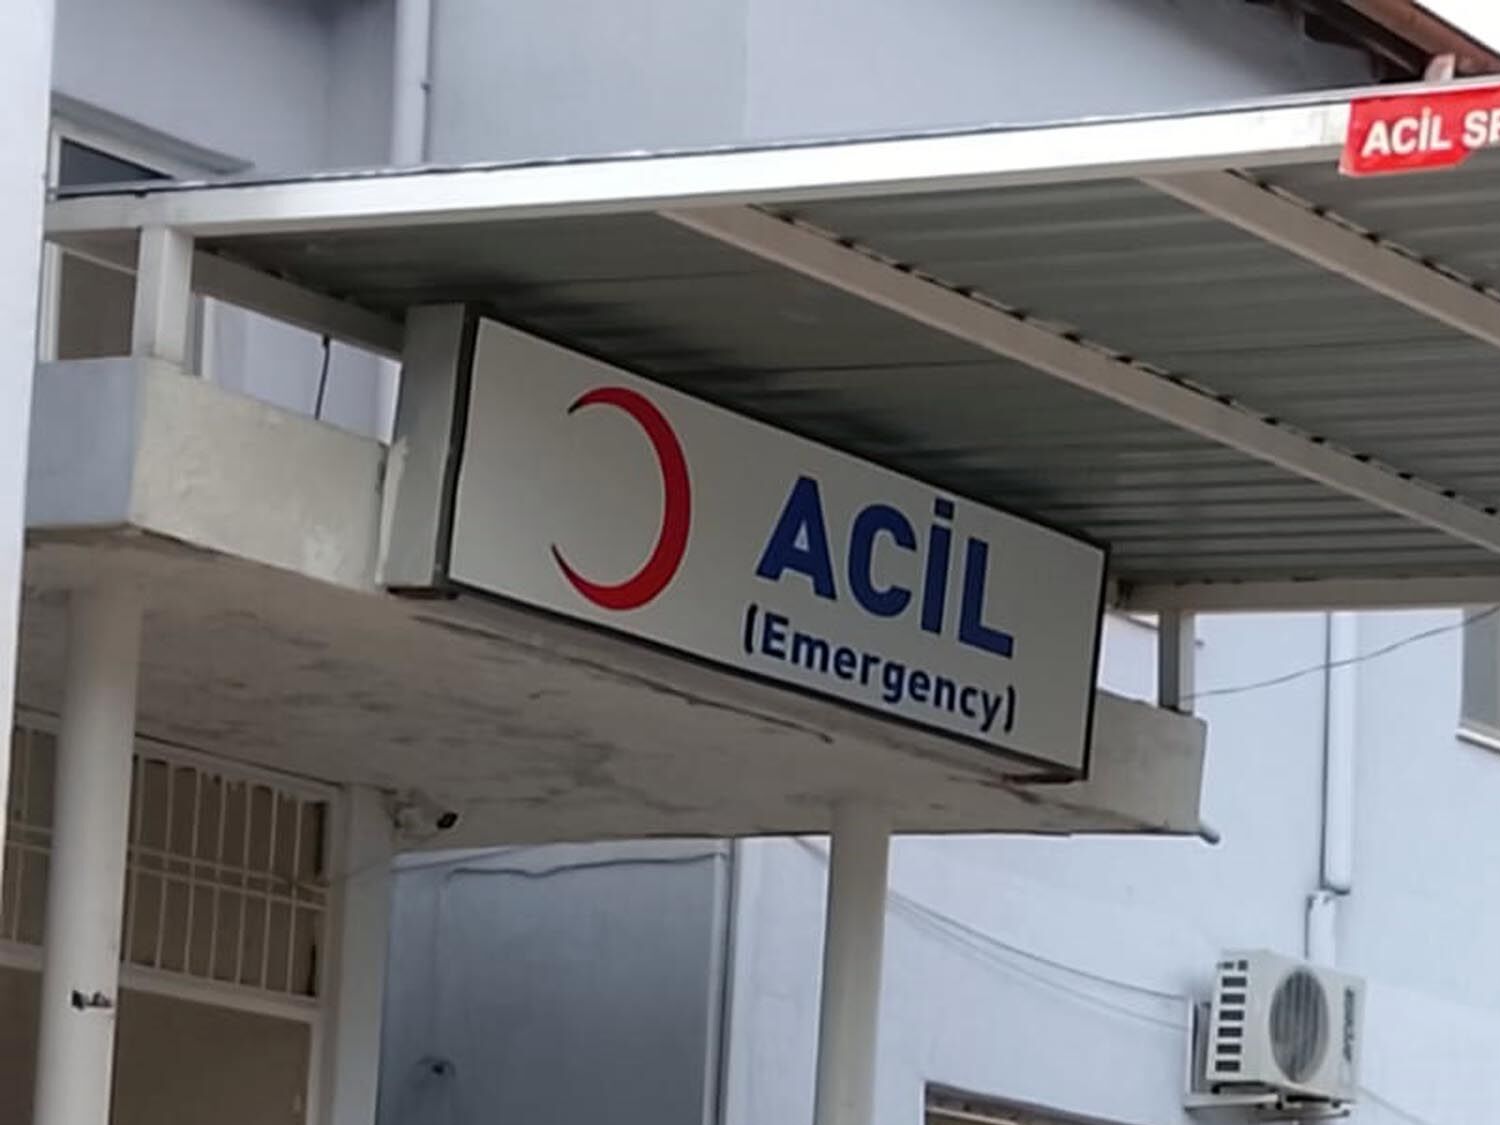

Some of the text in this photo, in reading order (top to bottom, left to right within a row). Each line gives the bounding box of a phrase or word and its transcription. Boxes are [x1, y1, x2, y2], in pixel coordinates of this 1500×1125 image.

[1360, 107, 1452, 157] ACİL
[756, 475, 1014, 659] ACİL
[743, 603, 1016, 734] (Emergency)
